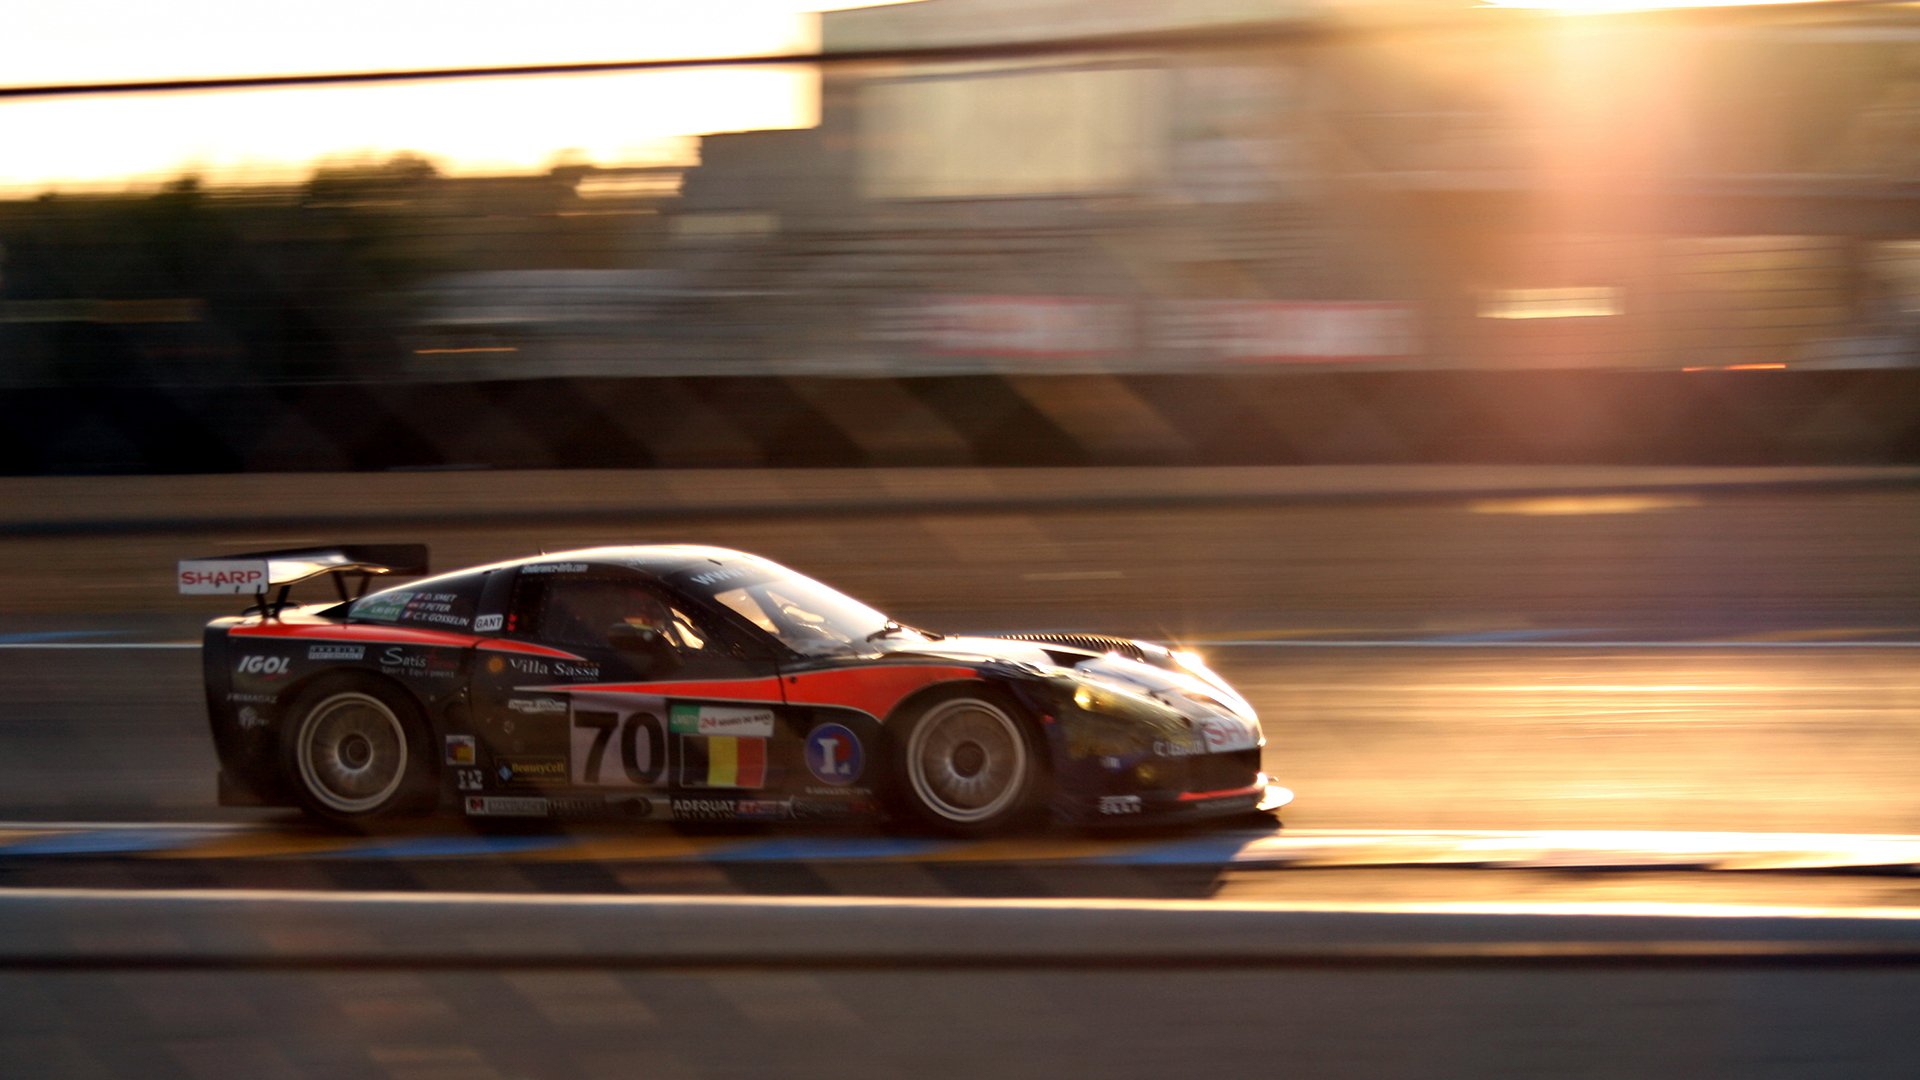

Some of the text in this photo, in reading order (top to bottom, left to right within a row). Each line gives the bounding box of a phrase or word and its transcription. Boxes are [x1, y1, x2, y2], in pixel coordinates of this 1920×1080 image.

[181, 570, 262, 586] SHARP
[428, 613, 469, 626] GOSSELIN
[475, 616, 501, 628] GANT
[238, 655, 290, 674] IGOL
[509, 658, 600, 677] Villa Sassa
[574, 710, 666, 785] 70
[674, 801, 736, 812] ADEQUAT
